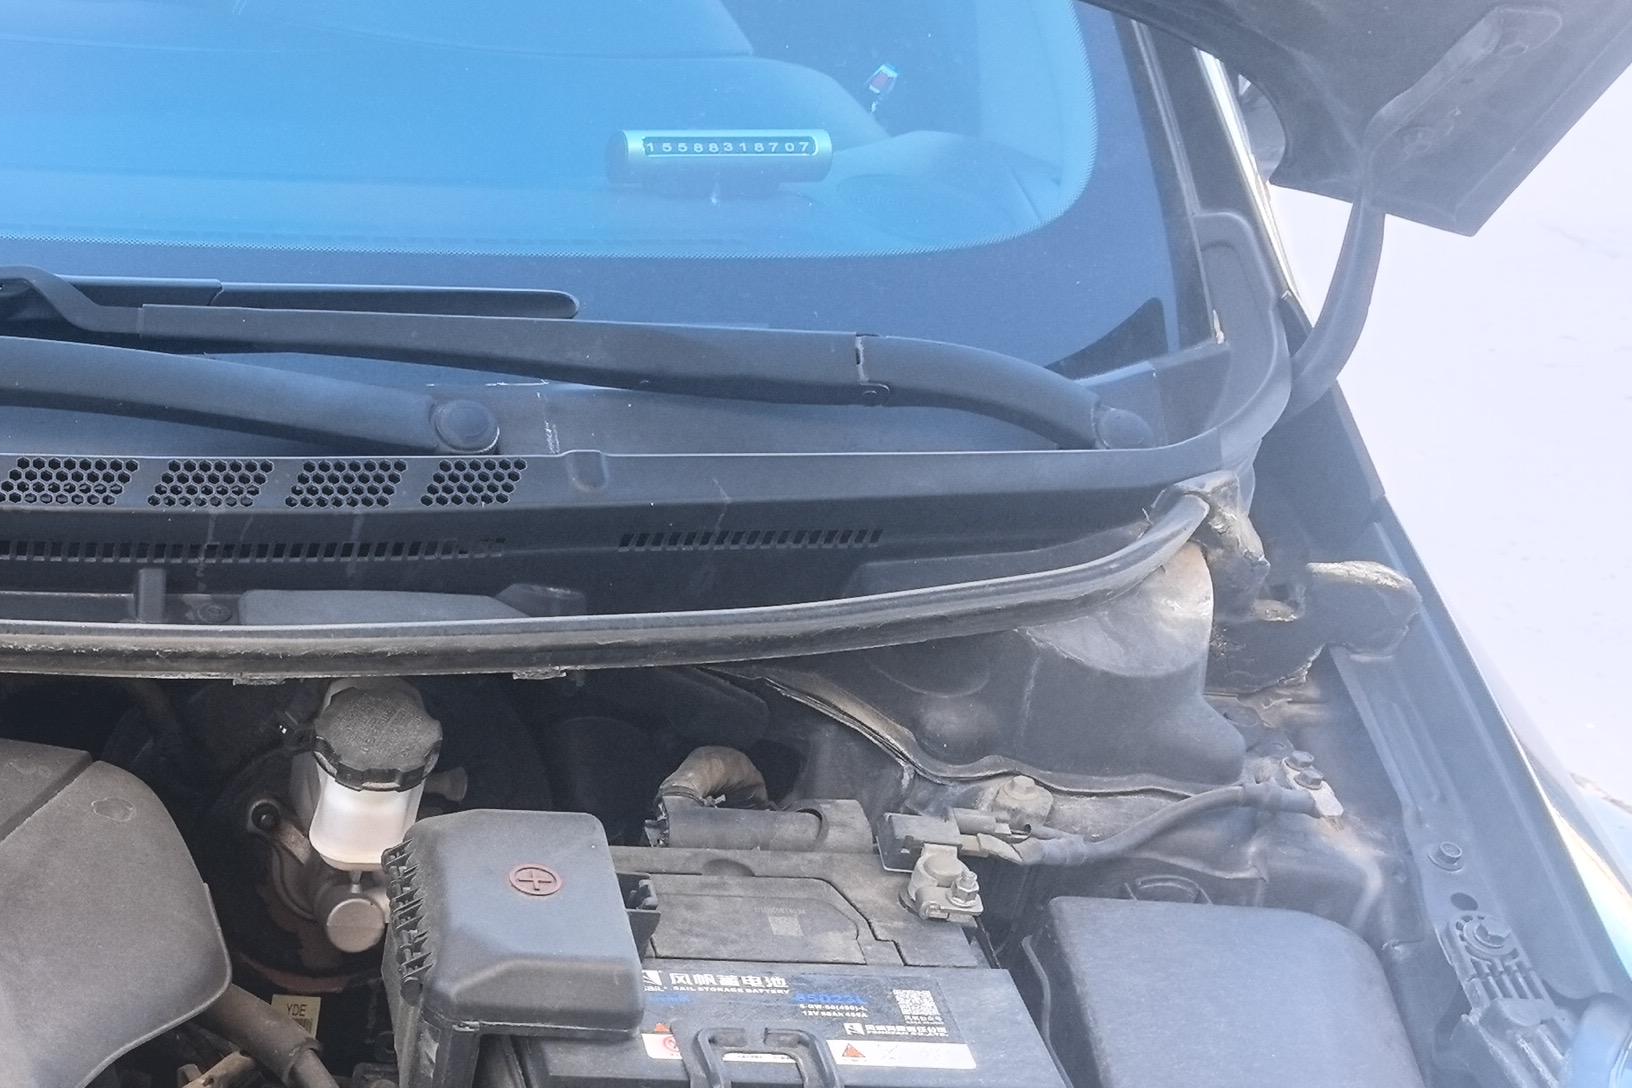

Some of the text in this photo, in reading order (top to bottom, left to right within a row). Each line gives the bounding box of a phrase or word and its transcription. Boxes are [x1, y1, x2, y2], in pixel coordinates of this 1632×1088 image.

[646, 141, 810, 153] 15588318707
[669, 972, 789, 988] 风帆蓄电池
